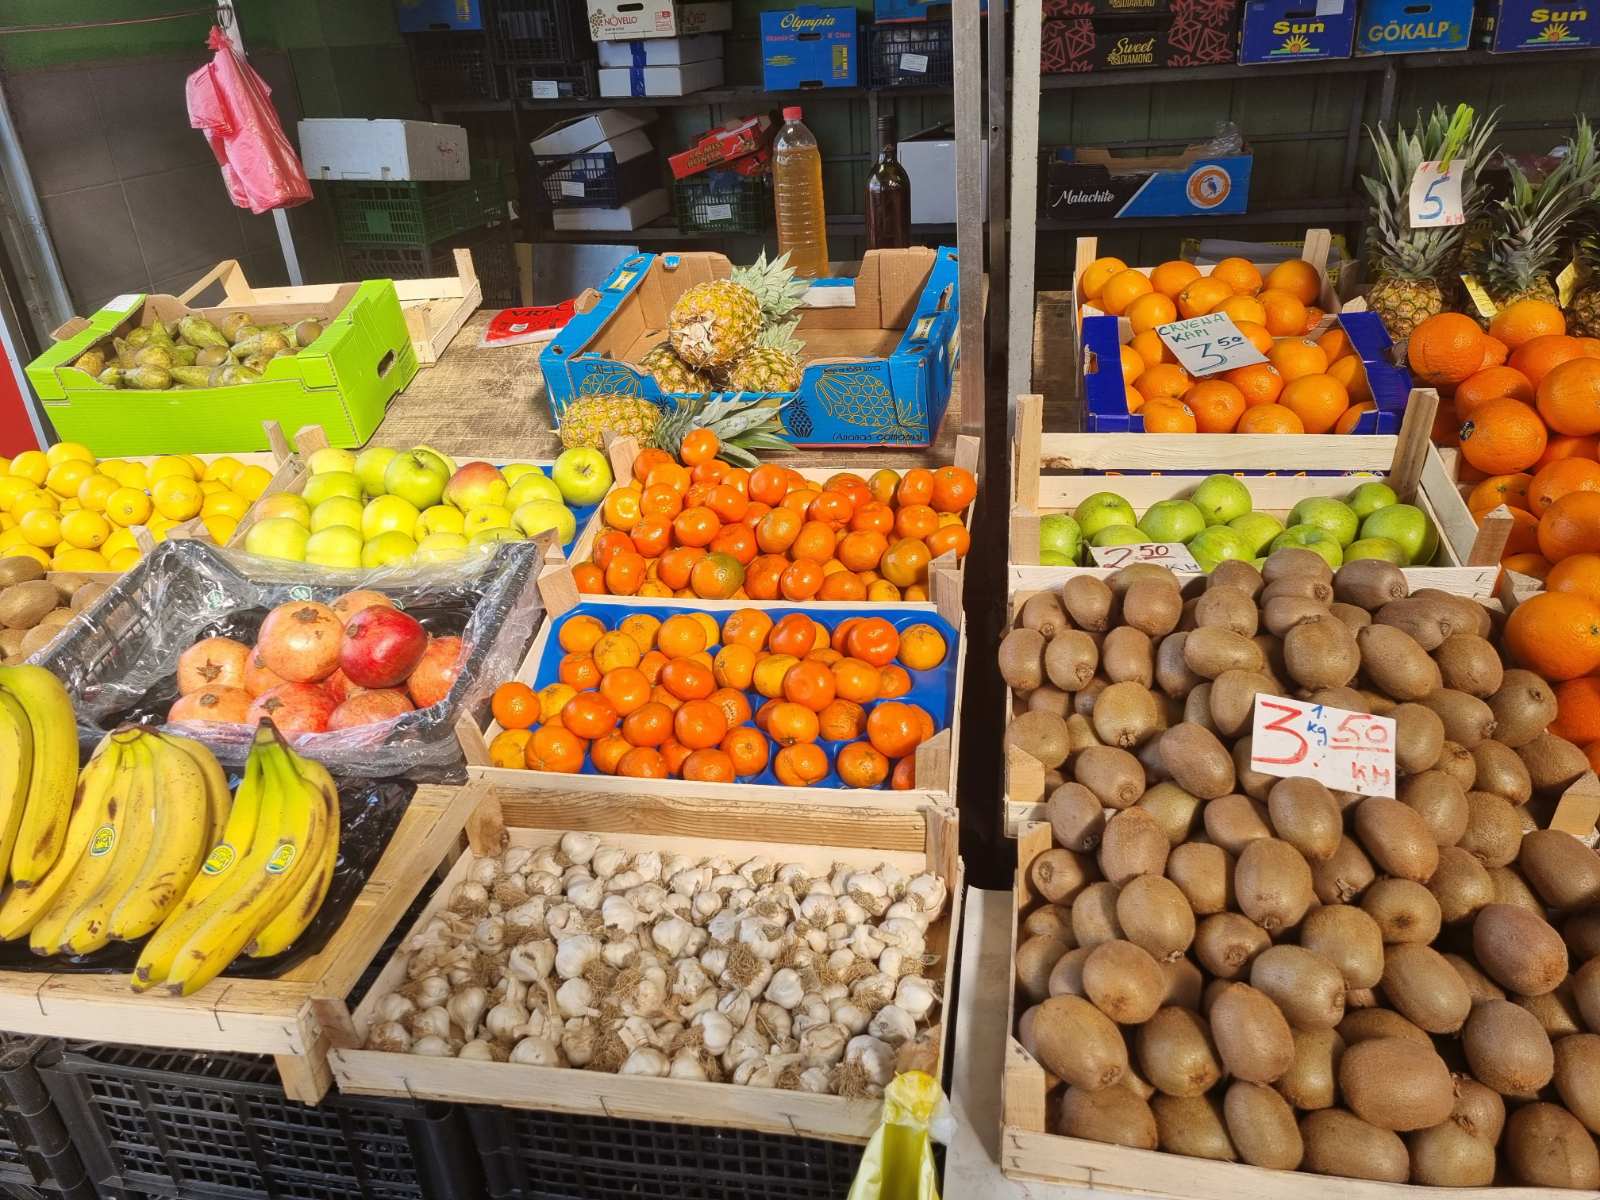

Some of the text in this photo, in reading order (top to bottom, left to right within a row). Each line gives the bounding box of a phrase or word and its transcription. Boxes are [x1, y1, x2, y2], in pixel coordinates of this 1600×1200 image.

[603, 14, 638, 27] NOVELLO
[780, 13, 836, 32] Olympia
[1531, 8, 1588, 24] Sun
[1272, 20, 1326, 36] Sun
[1368, 19, 1449, 42] GÖKALP
[1111, 37, 1156, 56] Sweet
[1120, 53, 1153, 65] DIAMOND
[1052, 188, 1116, 208] Malachite
[1417, 175, 1450, 220] 5
[1171, 328, 1210, 343] KAPI
[1184, 342, 1228, 372] 3
[1139, 544, 1169, 558] 50
[1330, 714, 1389, 745] 50
